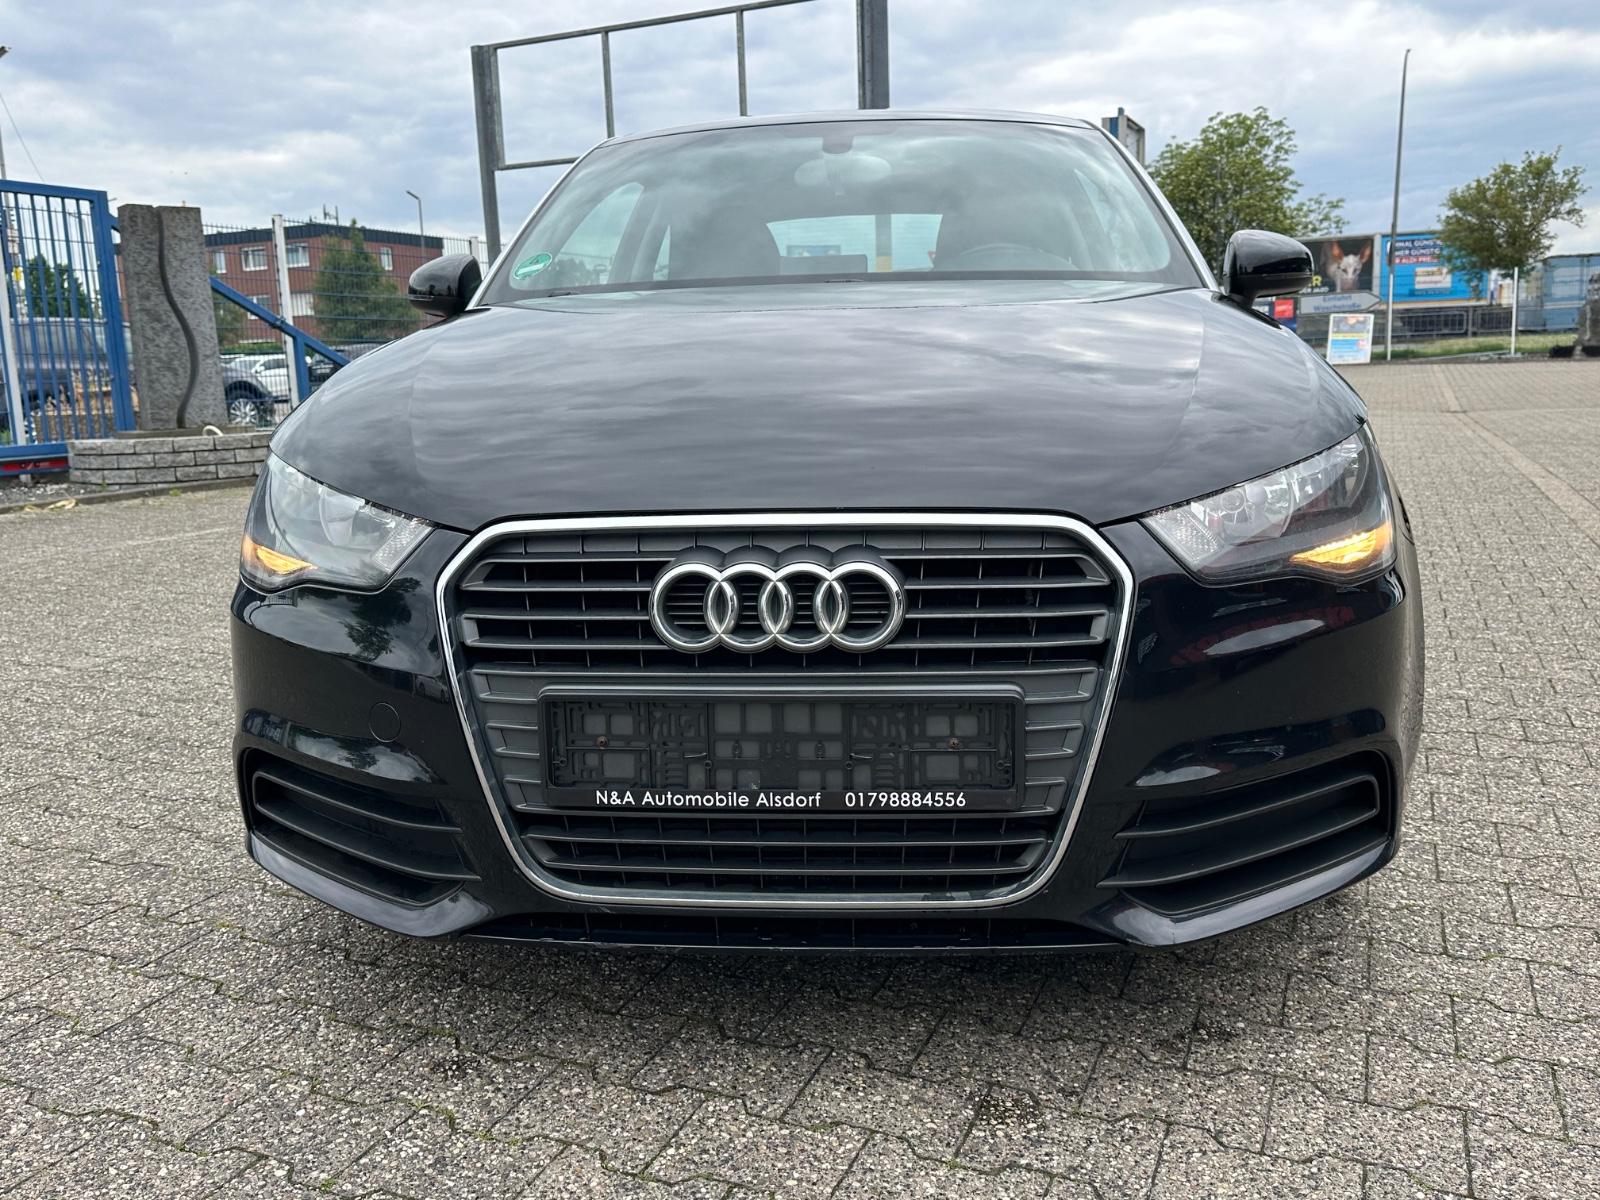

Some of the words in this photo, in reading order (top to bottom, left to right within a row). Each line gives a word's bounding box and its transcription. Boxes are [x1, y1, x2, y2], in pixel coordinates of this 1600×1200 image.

[595, 790, 635, 805] N&A
[641, 791, 750, 807] Automobile
[755, 791, 822, 807] Alsdorf
[844, 791, 967, 807] 01798884556
